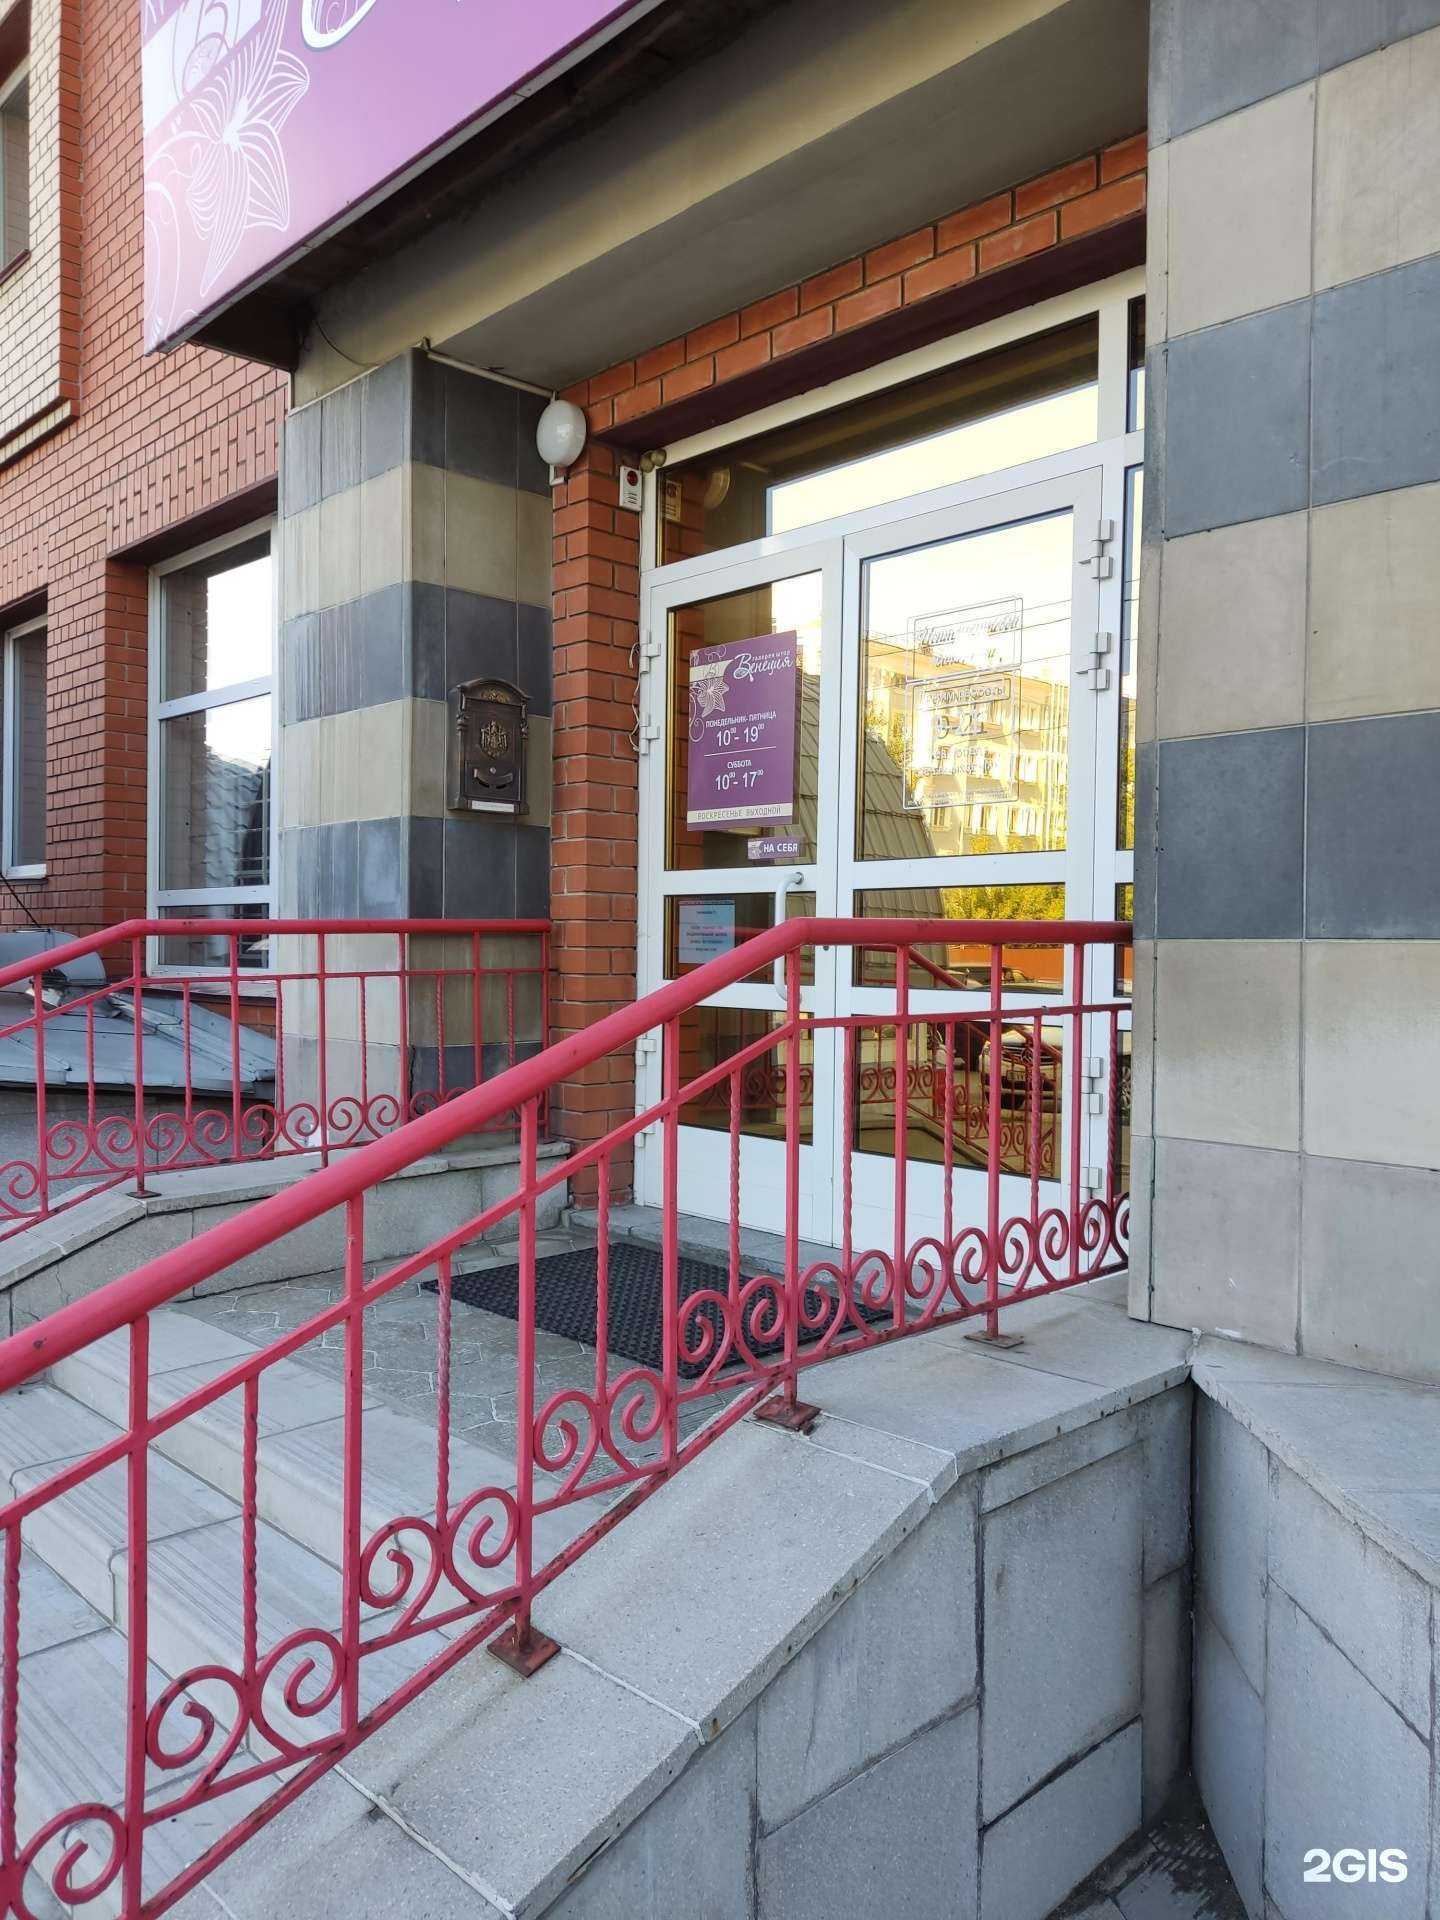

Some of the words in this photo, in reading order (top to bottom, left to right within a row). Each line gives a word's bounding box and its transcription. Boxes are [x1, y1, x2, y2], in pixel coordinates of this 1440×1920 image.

[733, 653, 793, 682] Венеция
[727, 760, 752, 768] СУББОТА
[697, 810, 742, 820] ВОСКРЕСЕНЬЕ
[746, 805, 782, 817] ВЫХОДНОЙ
[763, 844, 775, 853] НА
[777, 843, 798, 852] СЕБЯ
